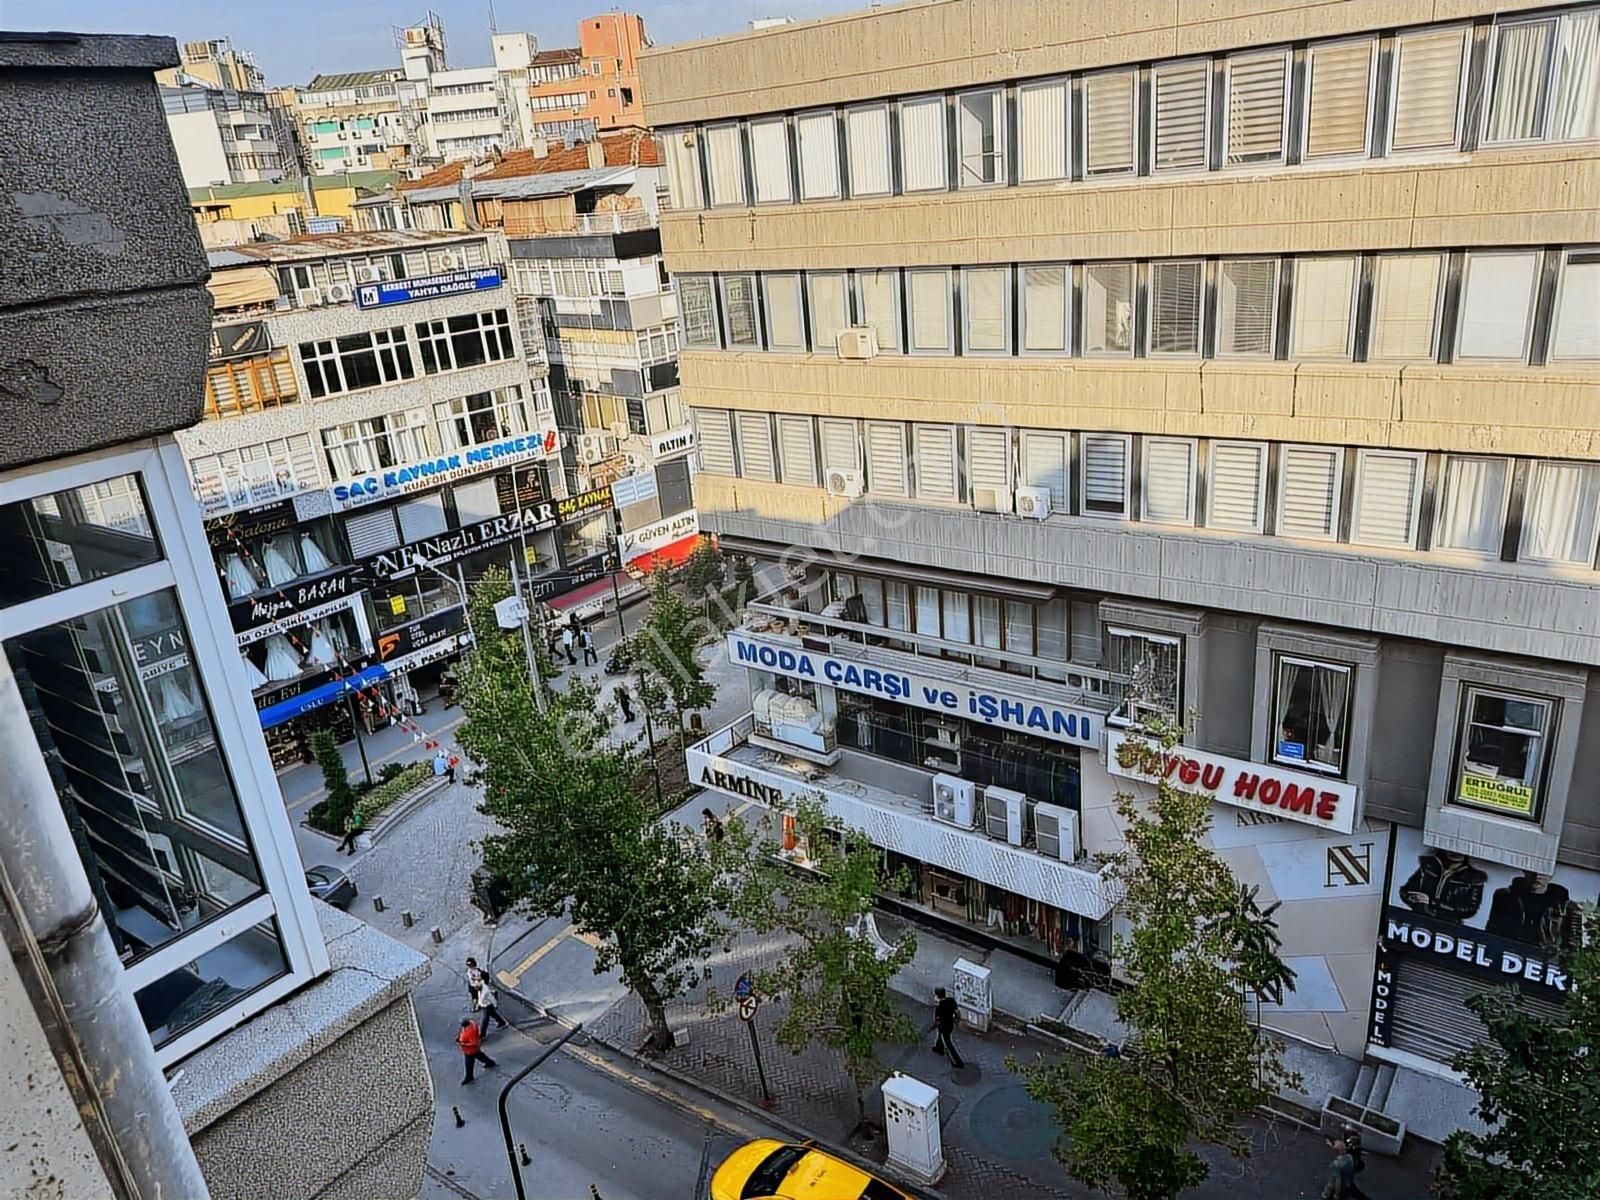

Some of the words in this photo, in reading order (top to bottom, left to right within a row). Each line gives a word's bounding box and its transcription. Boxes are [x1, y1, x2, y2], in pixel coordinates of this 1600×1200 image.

[408, 289, 439, 299] YAHYA
[333, 476, 379, 501] SAÇ
[384, 454, 462, 489] KAYNAK
[466, 433, 543, 465] MERKEZİ
[659, 435, 687, 454] ALTIN
[420, 530, 475, 559] Nazlı
[478, 503, 556, 541] ERZAR
[639, 523, 670, 543] GÜVEN
[672, 514, 695, 531] ALTIN
[252, 599, 294, 621] Müjgan
[737, 640, 816, 677] MODA
[824, 660, 911, 700] ÇARŞI
[923, 685, 959, 709] ve
[1233, 770, 1340, 821] HOME
[1386, 919, 1493, 968] MODEL
[1373, 969, 1392, 1038] MODEL
